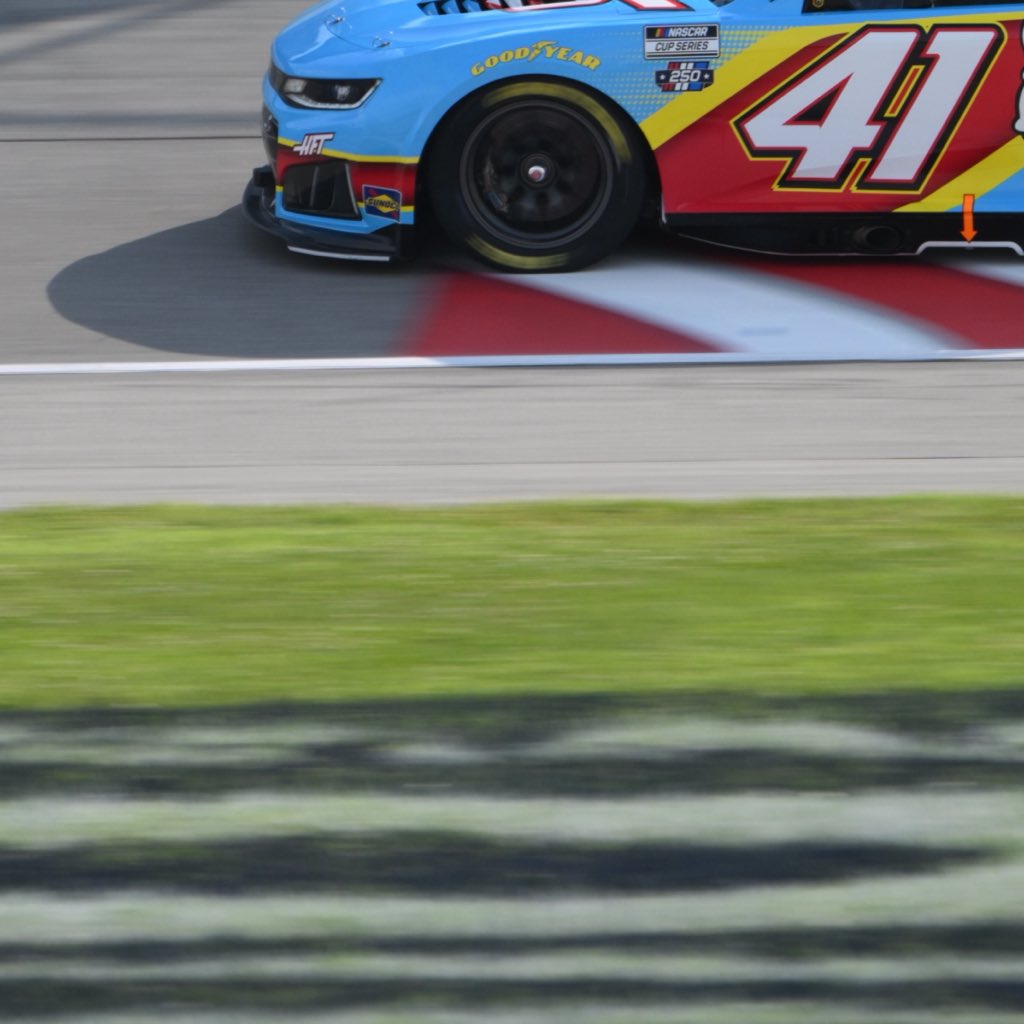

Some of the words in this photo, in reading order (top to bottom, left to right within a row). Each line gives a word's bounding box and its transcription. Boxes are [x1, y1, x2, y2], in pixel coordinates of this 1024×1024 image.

[667, 27, 709, 37] NASCAR
[655, 42, 674, 52] CUP
[675, 41, 709, 51] SERIES
[470, 40, 601, 76] GOODYEAR
[669, 70, 701, 82] 250
[732, 24, 1006, 192] 41
